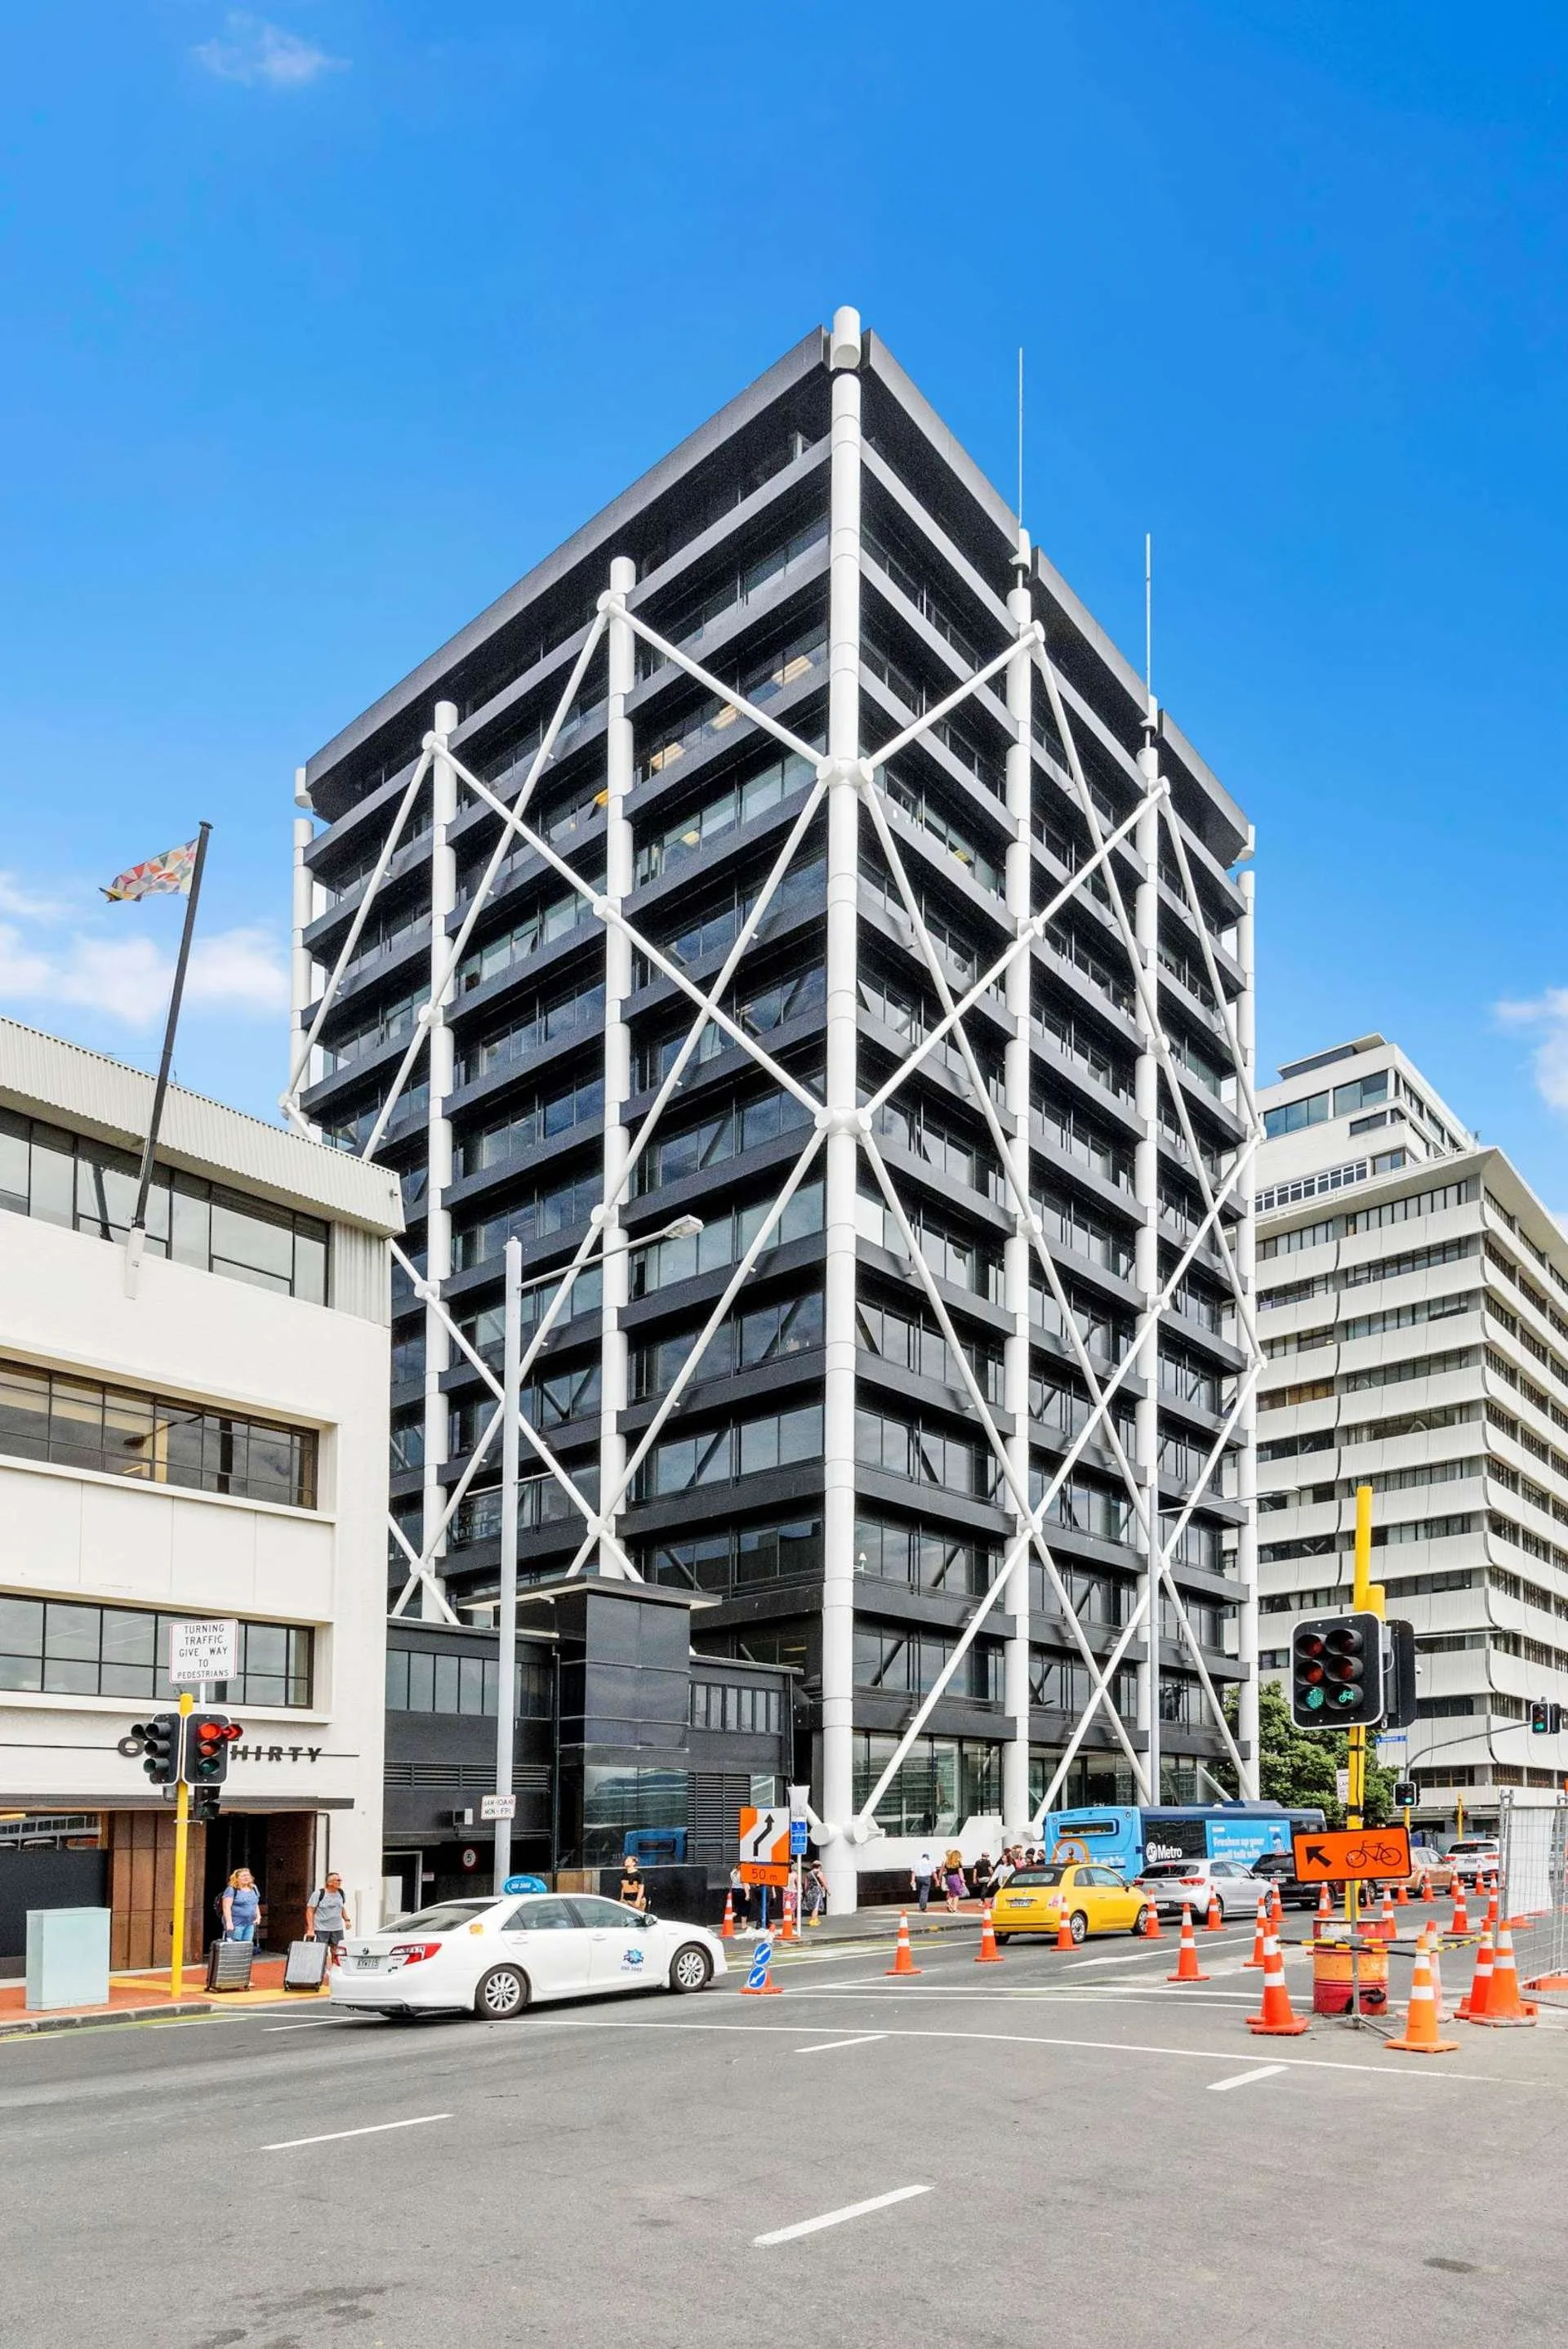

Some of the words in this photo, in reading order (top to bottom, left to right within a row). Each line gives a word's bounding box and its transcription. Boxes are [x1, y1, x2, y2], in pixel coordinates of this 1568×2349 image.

[184, 1624, 225, 1634] TURNING
[185, 1634, 224, 1645] TRAFFIC
[179, 1648, 199, 1657] GIVE
[209, 1647, 228, 1656] WAY
[198, 1659, 209, 1667] TO
[177, 1669, 229, 1679] PEDESTRIANS
[230, 1745, 322, 1763] HIRTY
[1157, 1844, 1183, 1859] Metro
[466, 1853, 472, 1862] 5
[751, 1868, 766, 1879] 50
